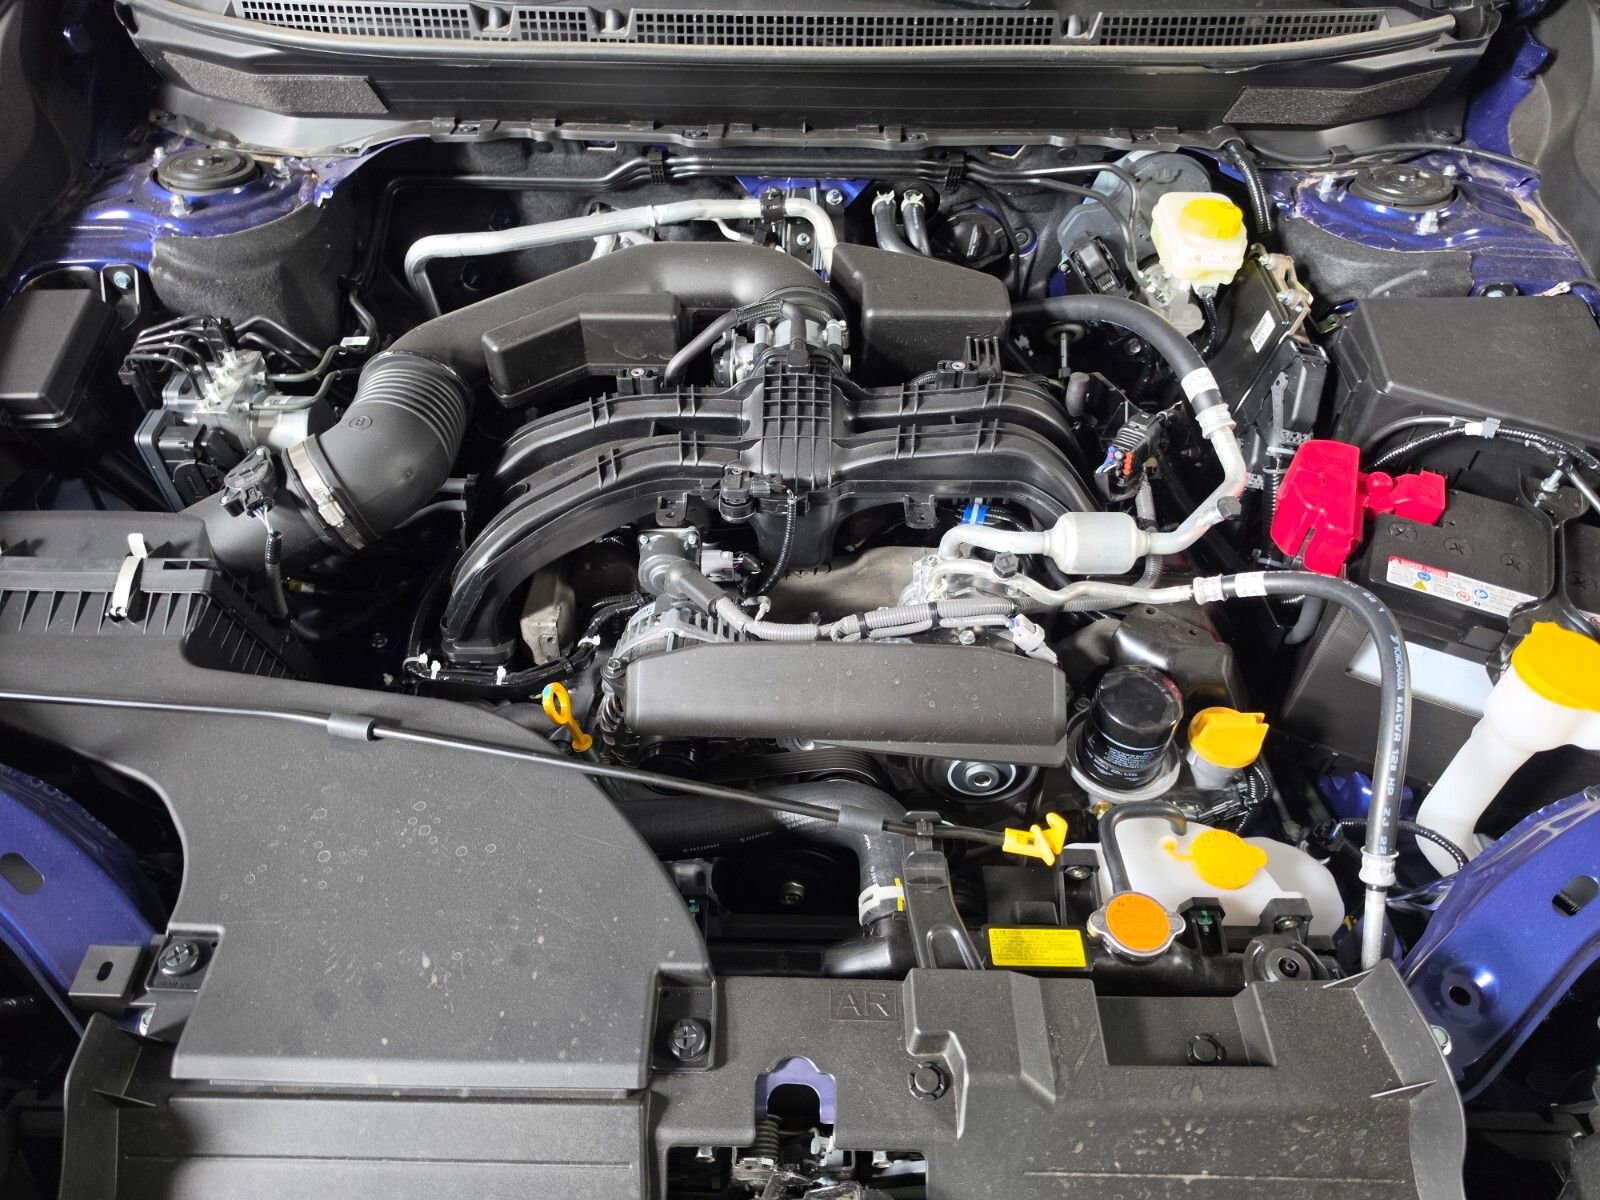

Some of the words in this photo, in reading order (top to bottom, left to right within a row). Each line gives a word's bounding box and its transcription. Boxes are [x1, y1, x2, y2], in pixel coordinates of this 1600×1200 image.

[1394, 646, 1404, 690] YOKOHAMA
[1387, 778, 1396, 796] HP
[836, 990, 891, 1017] AR
